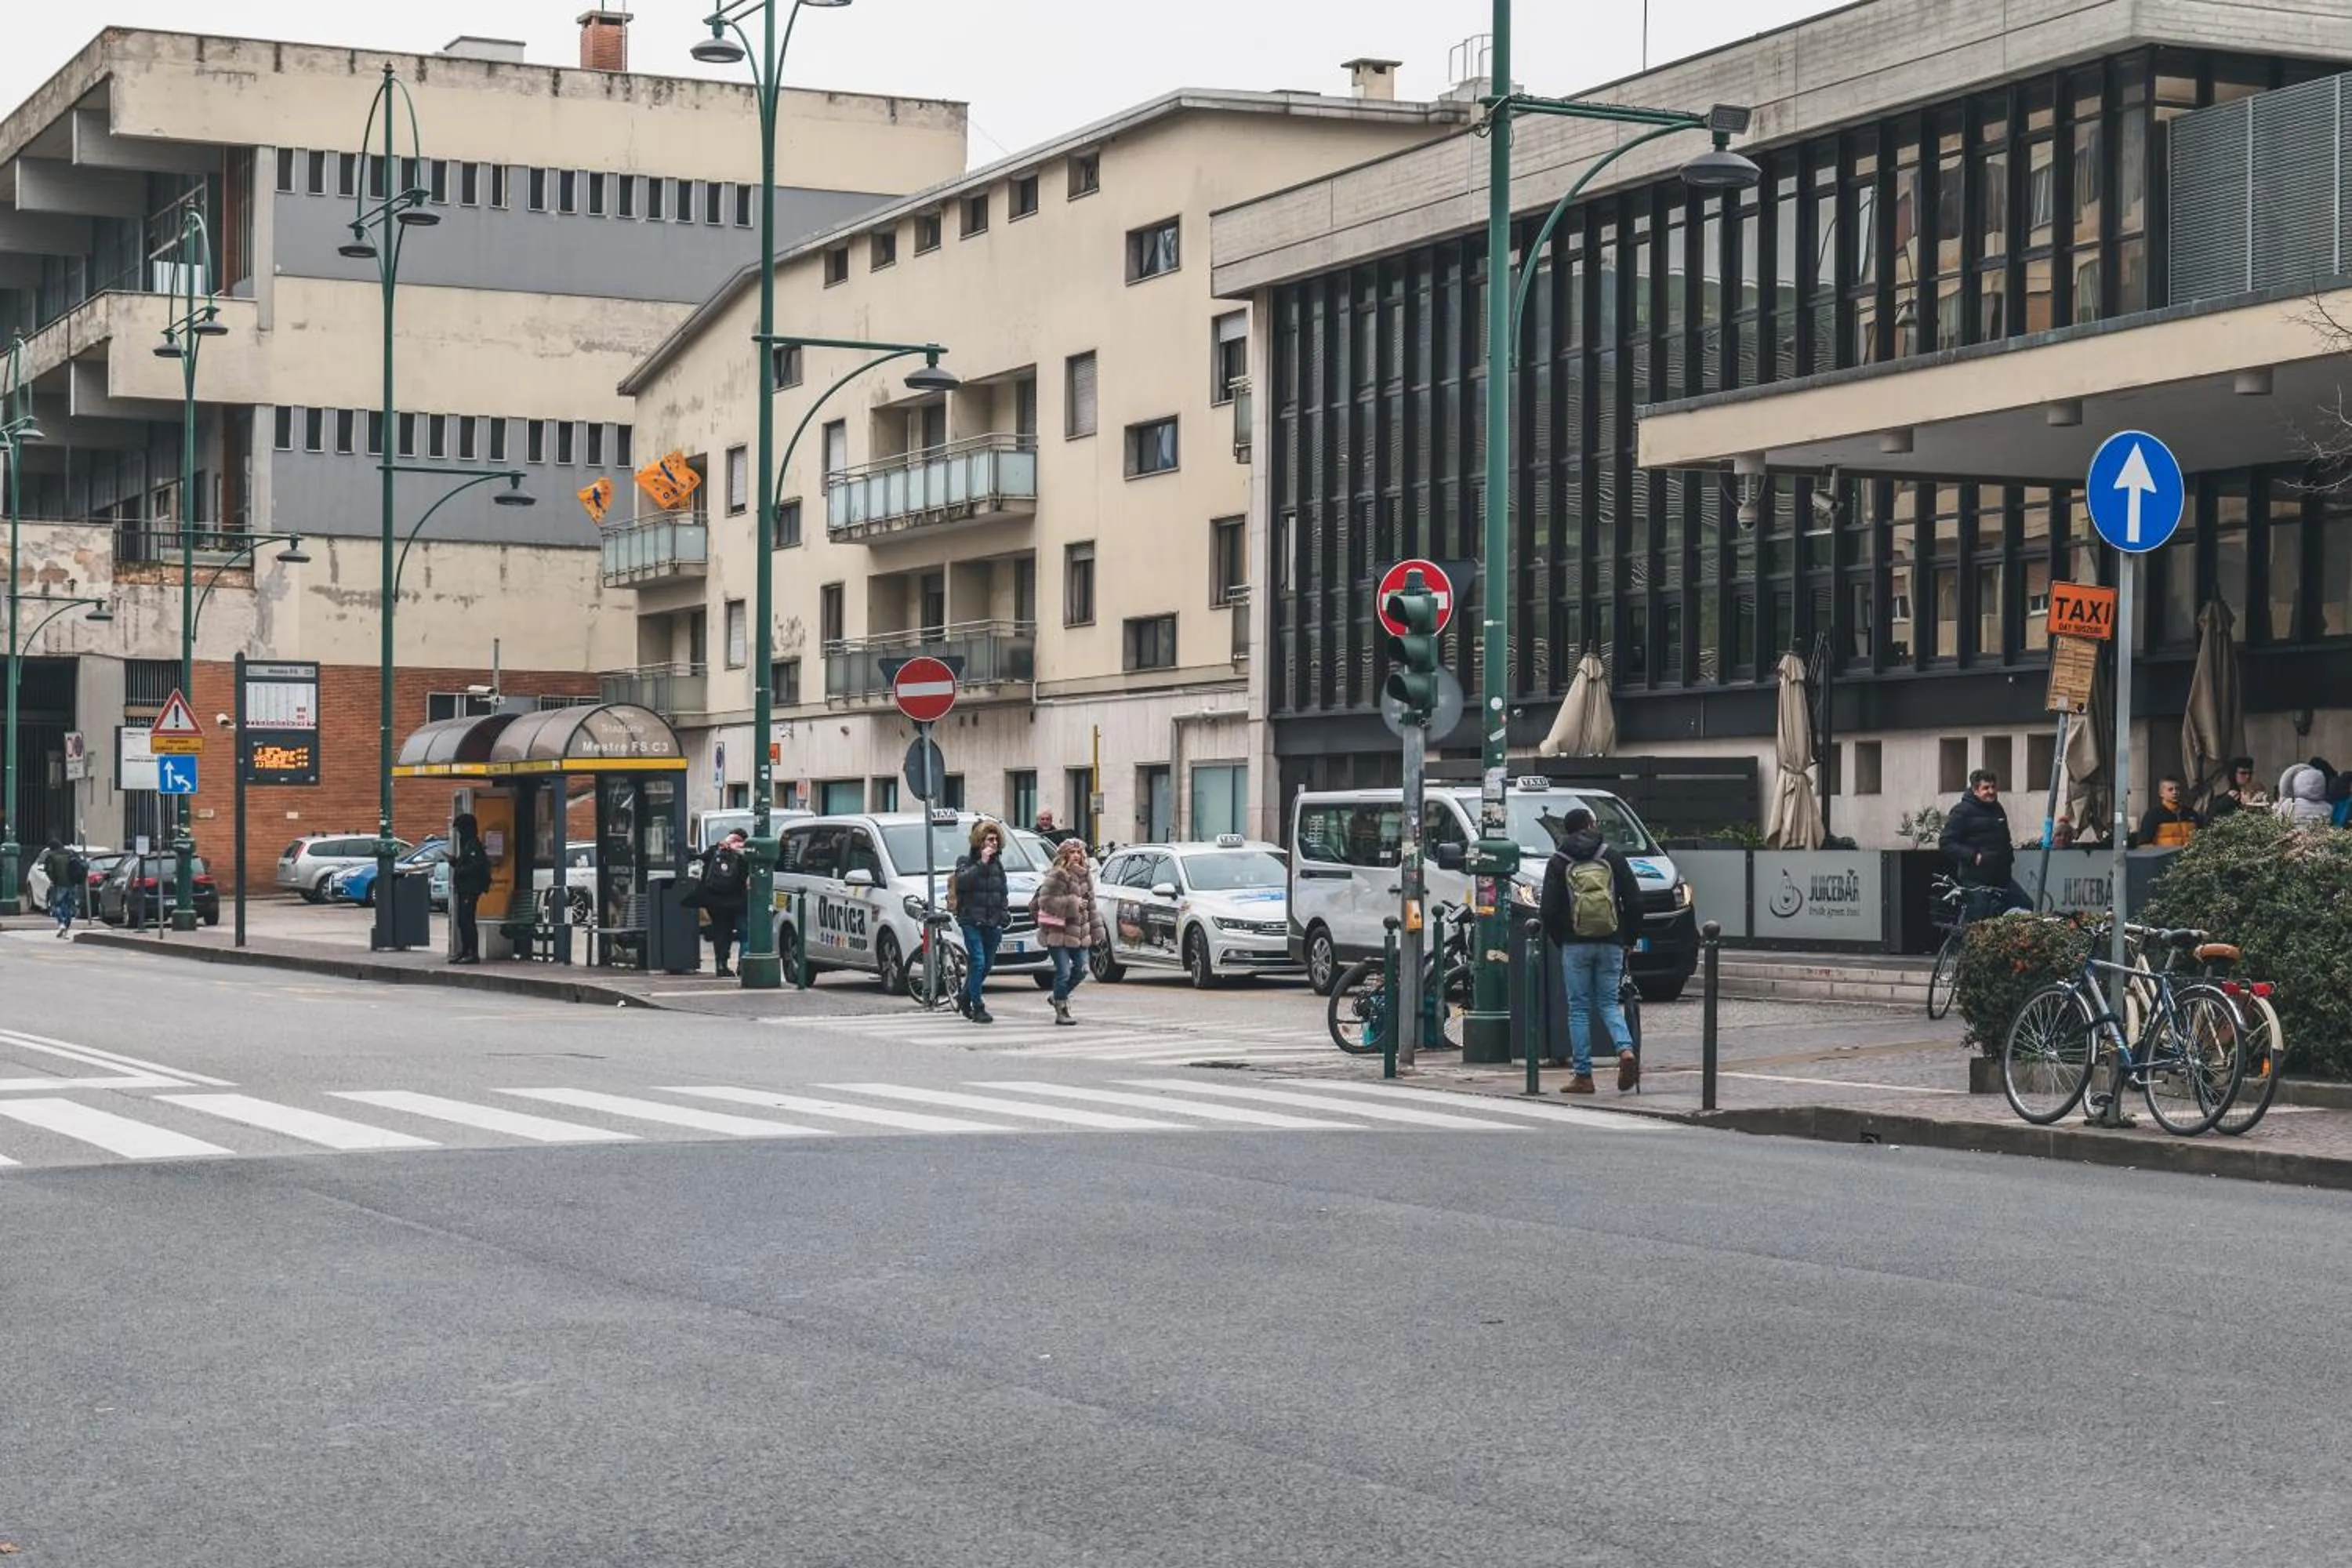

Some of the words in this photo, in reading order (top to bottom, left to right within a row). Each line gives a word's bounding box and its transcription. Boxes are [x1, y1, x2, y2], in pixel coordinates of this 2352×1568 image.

[2055, 597, 2111, 625] TAXI
[583, 741, 627, 753] Mestre
[631, 741, 648, 752] FS
[1808, 871, 1860, 902] JUICEBAR
[2062, 873, 2114, 906] JUICEBA
